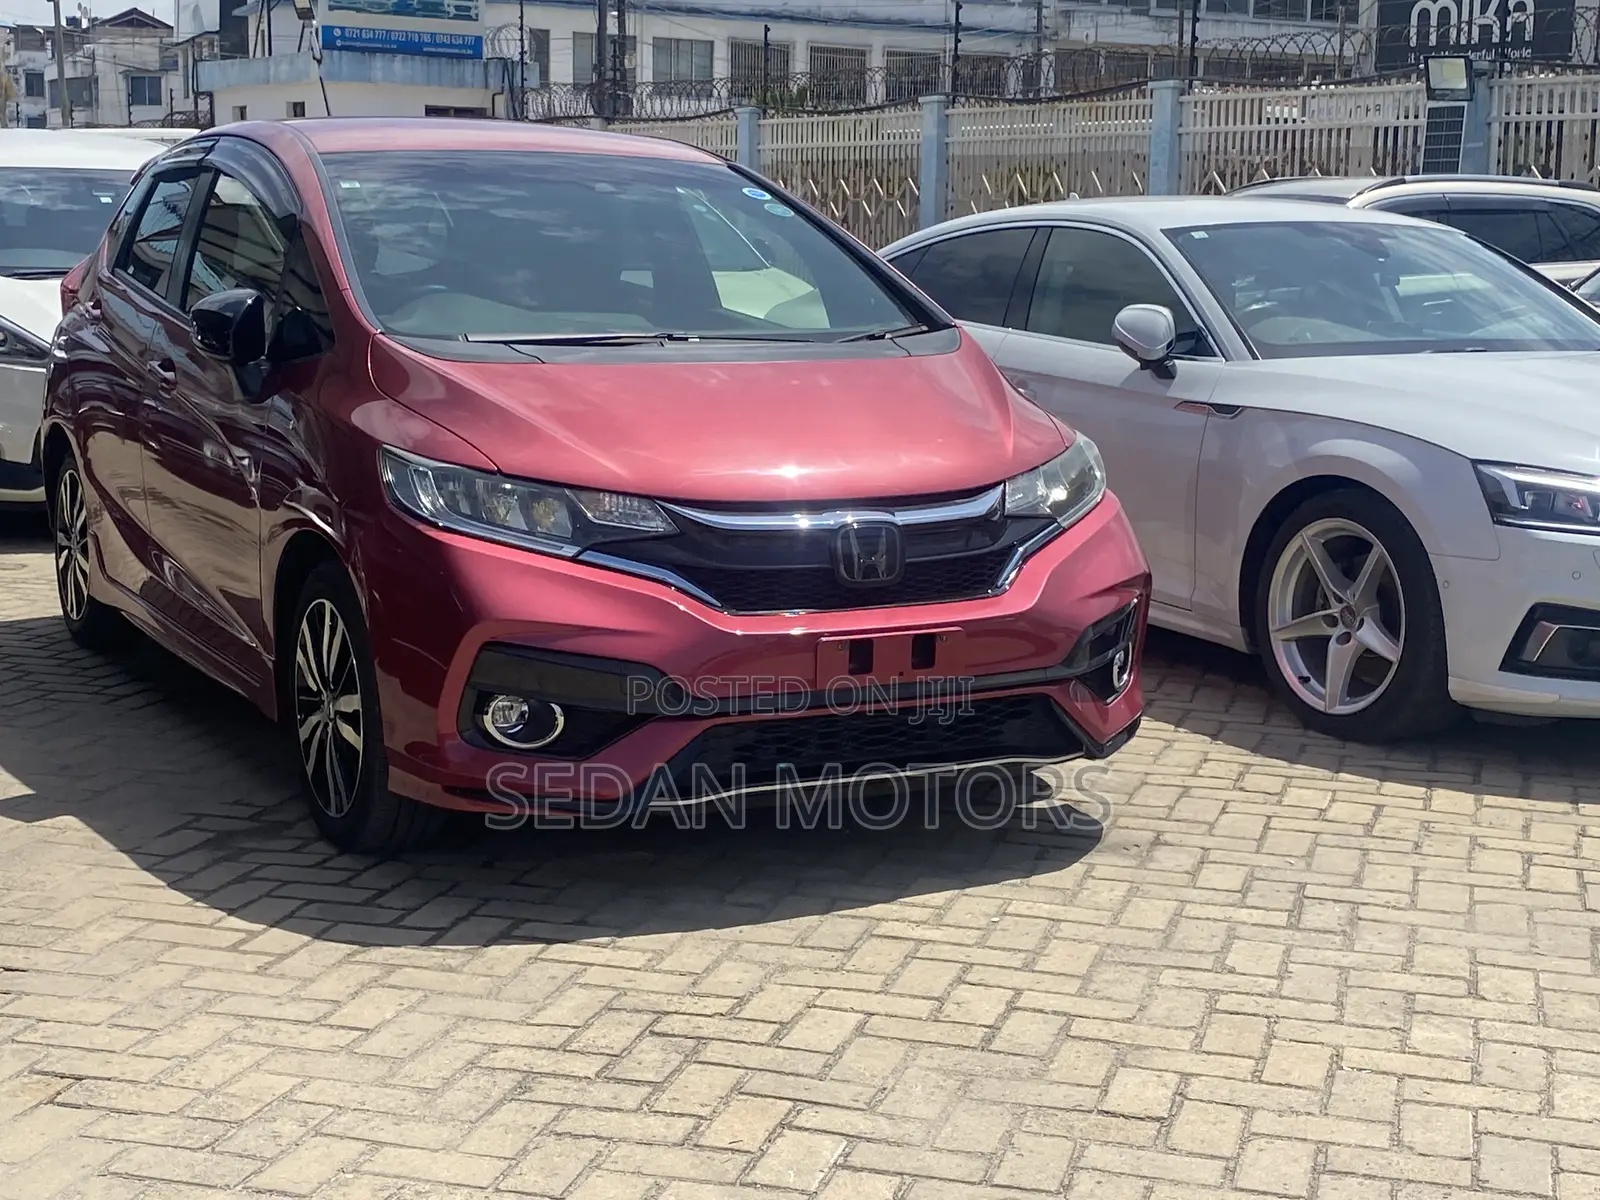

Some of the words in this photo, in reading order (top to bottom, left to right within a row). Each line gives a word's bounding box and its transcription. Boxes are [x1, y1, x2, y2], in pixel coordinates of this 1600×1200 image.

[345, 28, 360, 39] 0721
[375, 30, 387, 41] 777
[390, 31, 406, 42] 0722
[464, 36, 476, 46] 777
[1409, 0, 1536, 48] mika
